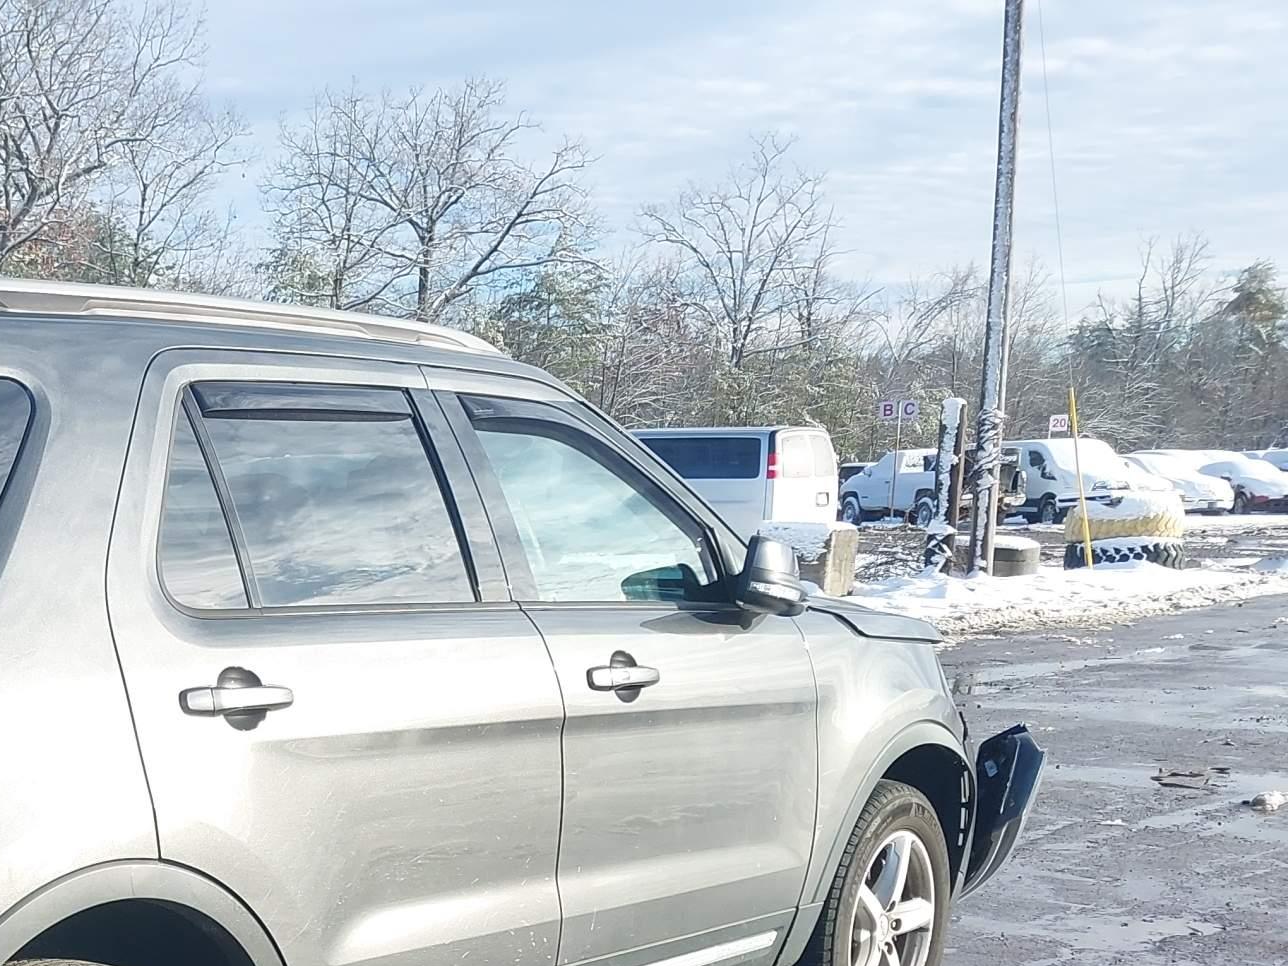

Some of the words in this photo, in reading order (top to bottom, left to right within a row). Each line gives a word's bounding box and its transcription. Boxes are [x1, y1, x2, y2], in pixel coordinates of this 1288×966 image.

[883, 404, 894, 417] B
[904, 402, 915, 415] C
[1052, 418, 1067, 428] 20
